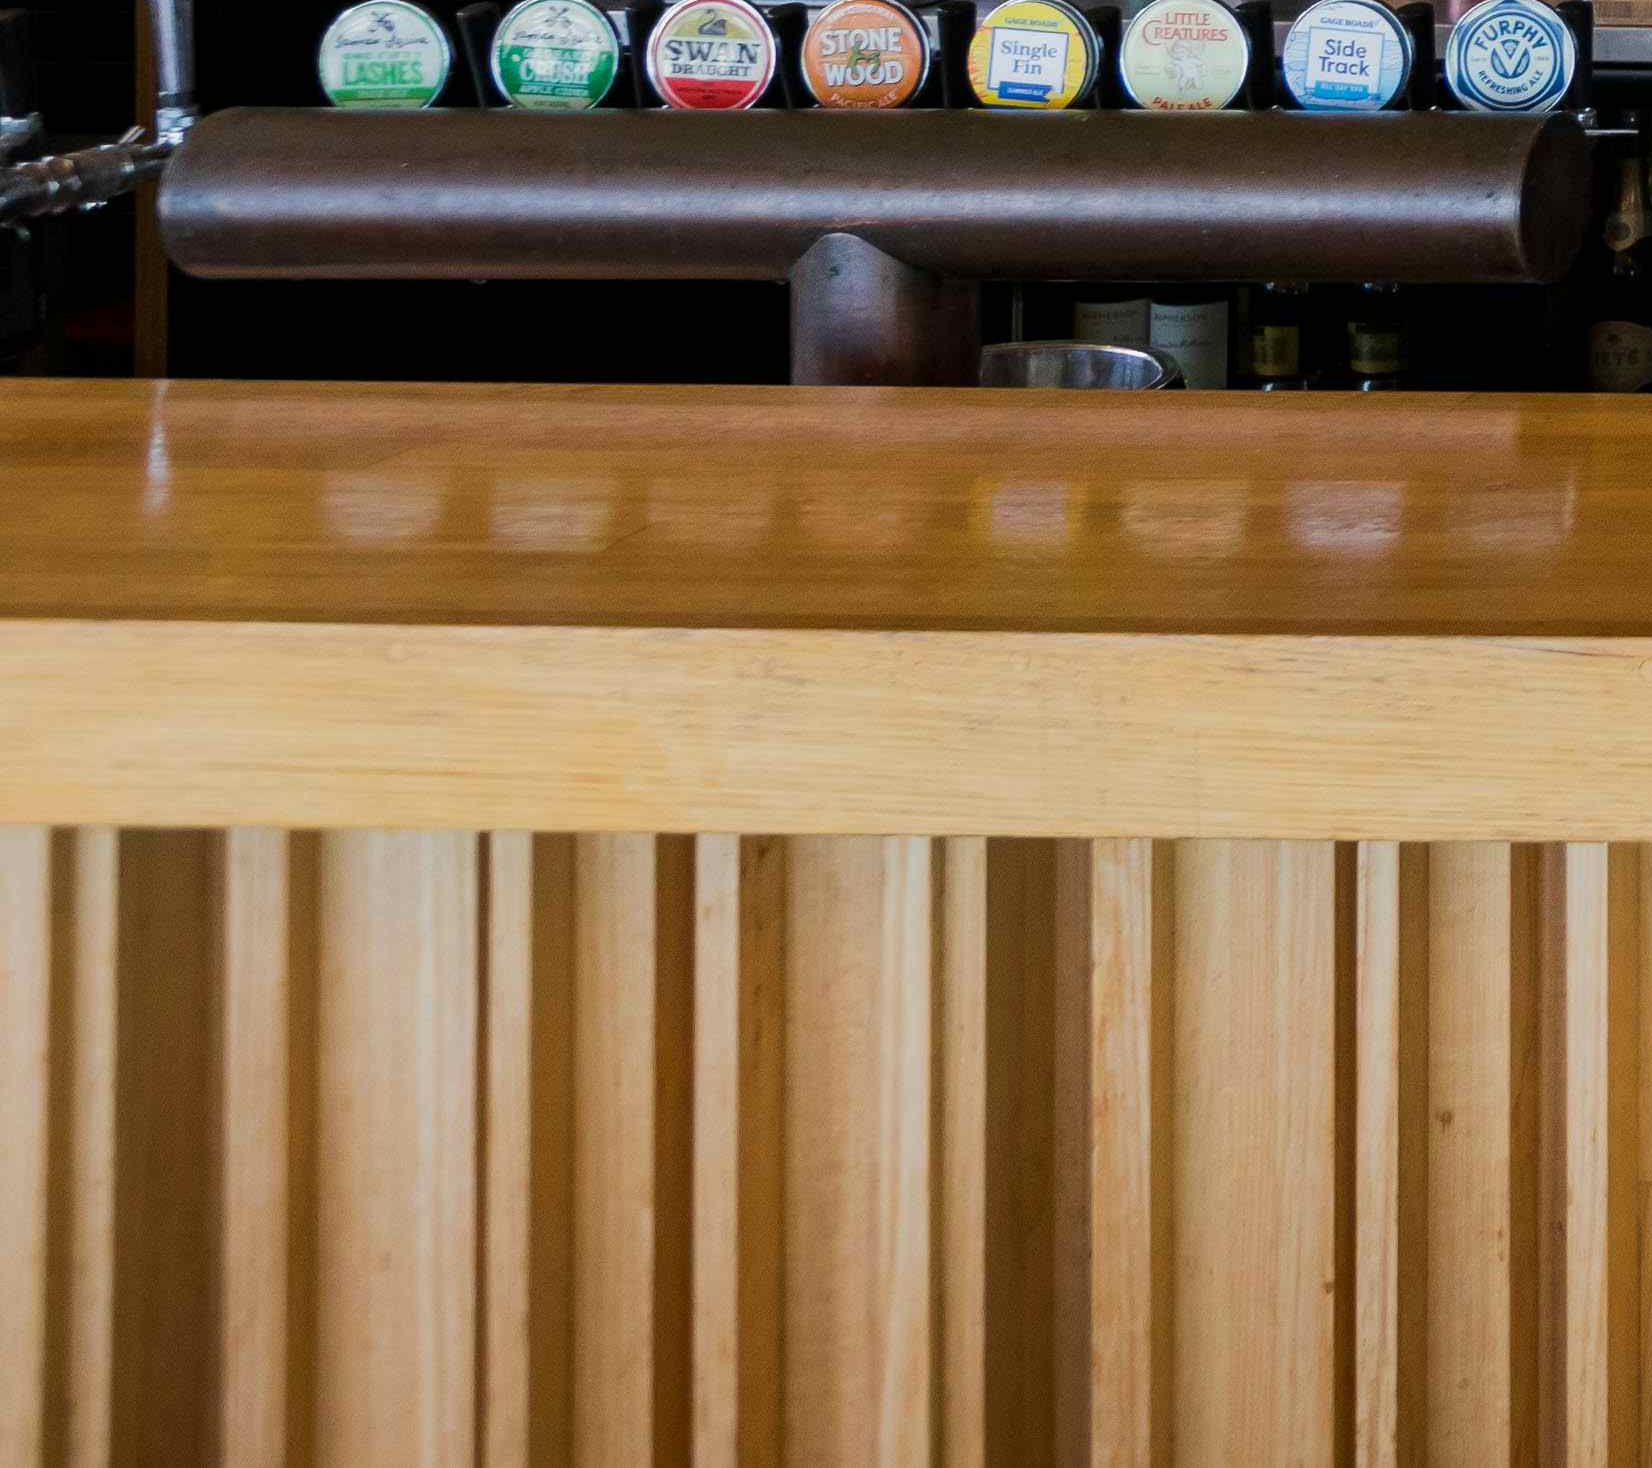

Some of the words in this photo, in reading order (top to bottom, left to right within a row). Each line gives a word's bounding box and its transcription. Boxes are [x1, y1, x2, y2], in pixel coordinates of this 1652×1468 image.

[1163, 11, 1211, 26] LITTLE
[820, 28, 903, 56] STONE
[1142, 18, 1229, 46] CREATURES
[1473, 19, 1549, 52] FURPHY
[999, 37, 1059, 63] Single
[1324, 38, 1367, 59] Side
[341, 61, 424, 86] LASHES
[671, 64, 751, 78] DRAUGHT
[823, 60, 905, 88] WOOD
[1012, 57, 1042, 77] Fin
[1318, 56, 1370, 77] Track
[1478, 69, 1528, 96] REFRESHING
[1528, 69, 1545, 90] ALE
